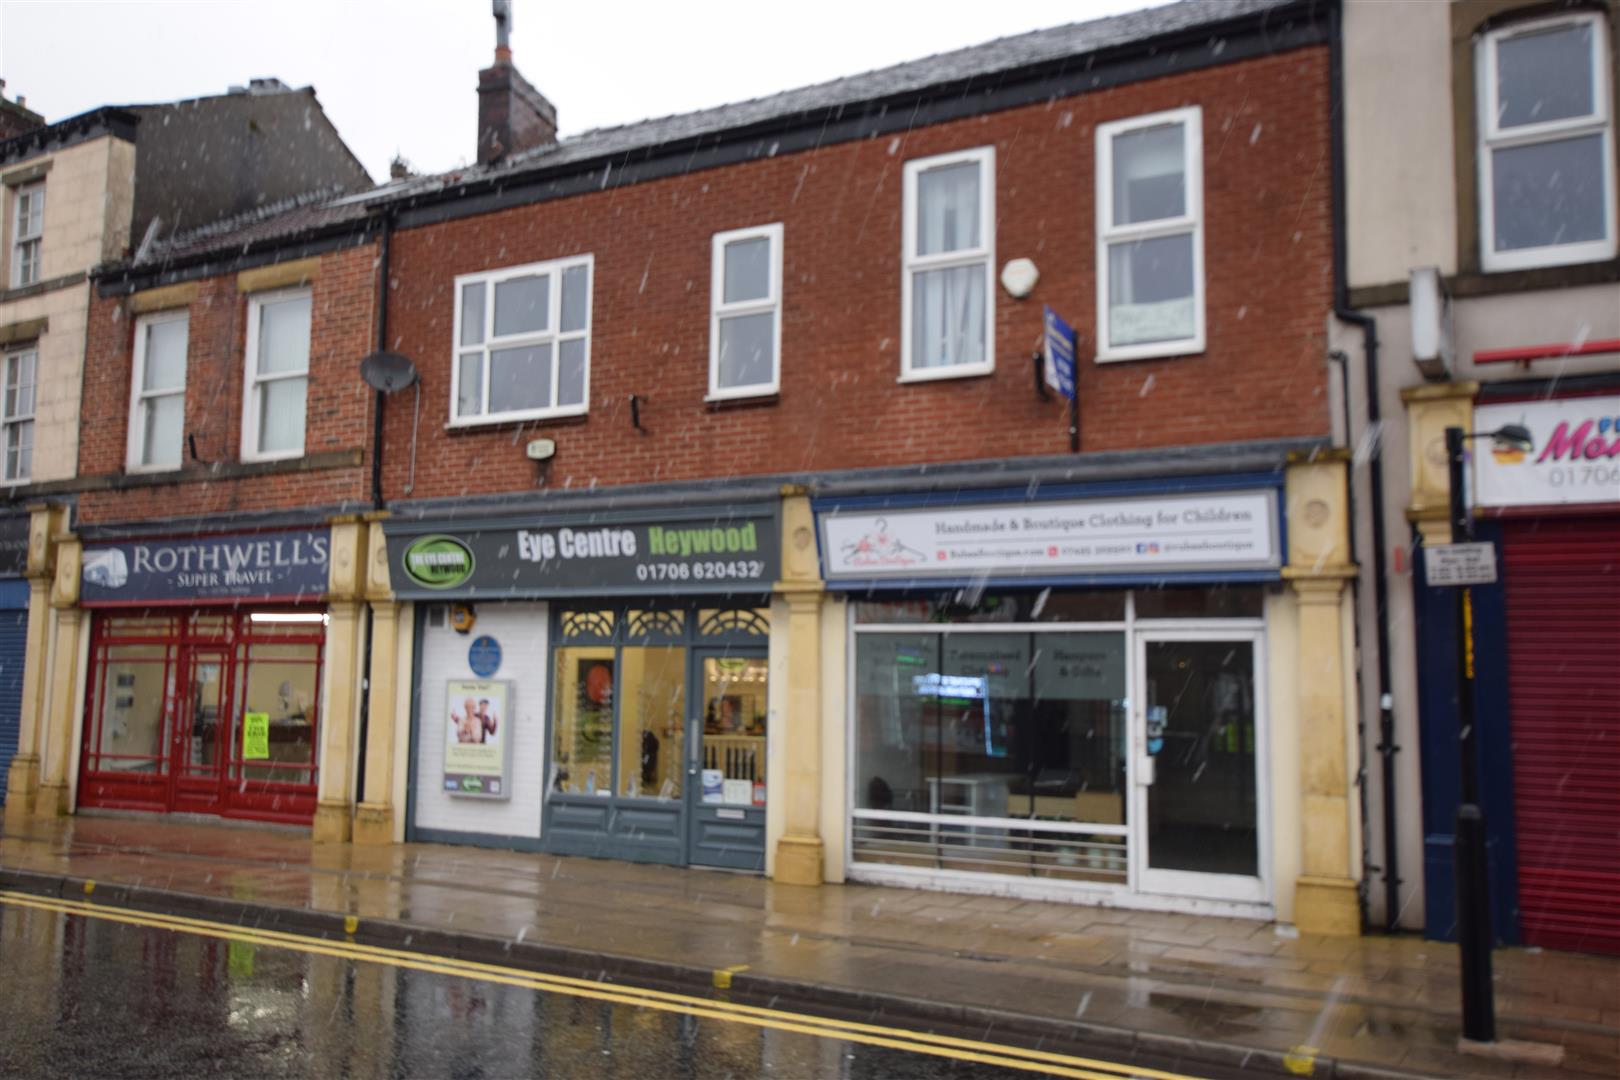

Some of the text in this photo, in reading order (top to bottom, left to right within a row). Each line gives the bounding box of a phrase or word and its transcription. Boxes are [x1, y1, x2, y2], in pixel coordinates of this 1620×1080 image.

[934, 505, 1253, 535] Handmade & Boutique Clothing for Children
[134, 533, 327, 573] ROTHWELL'S
[517, 521, 757, 562] Eye Centre Heywood
[177, 568, 274, 587] SUPER TRAVEL
[636, 560, 760, 581] 01706 620432
